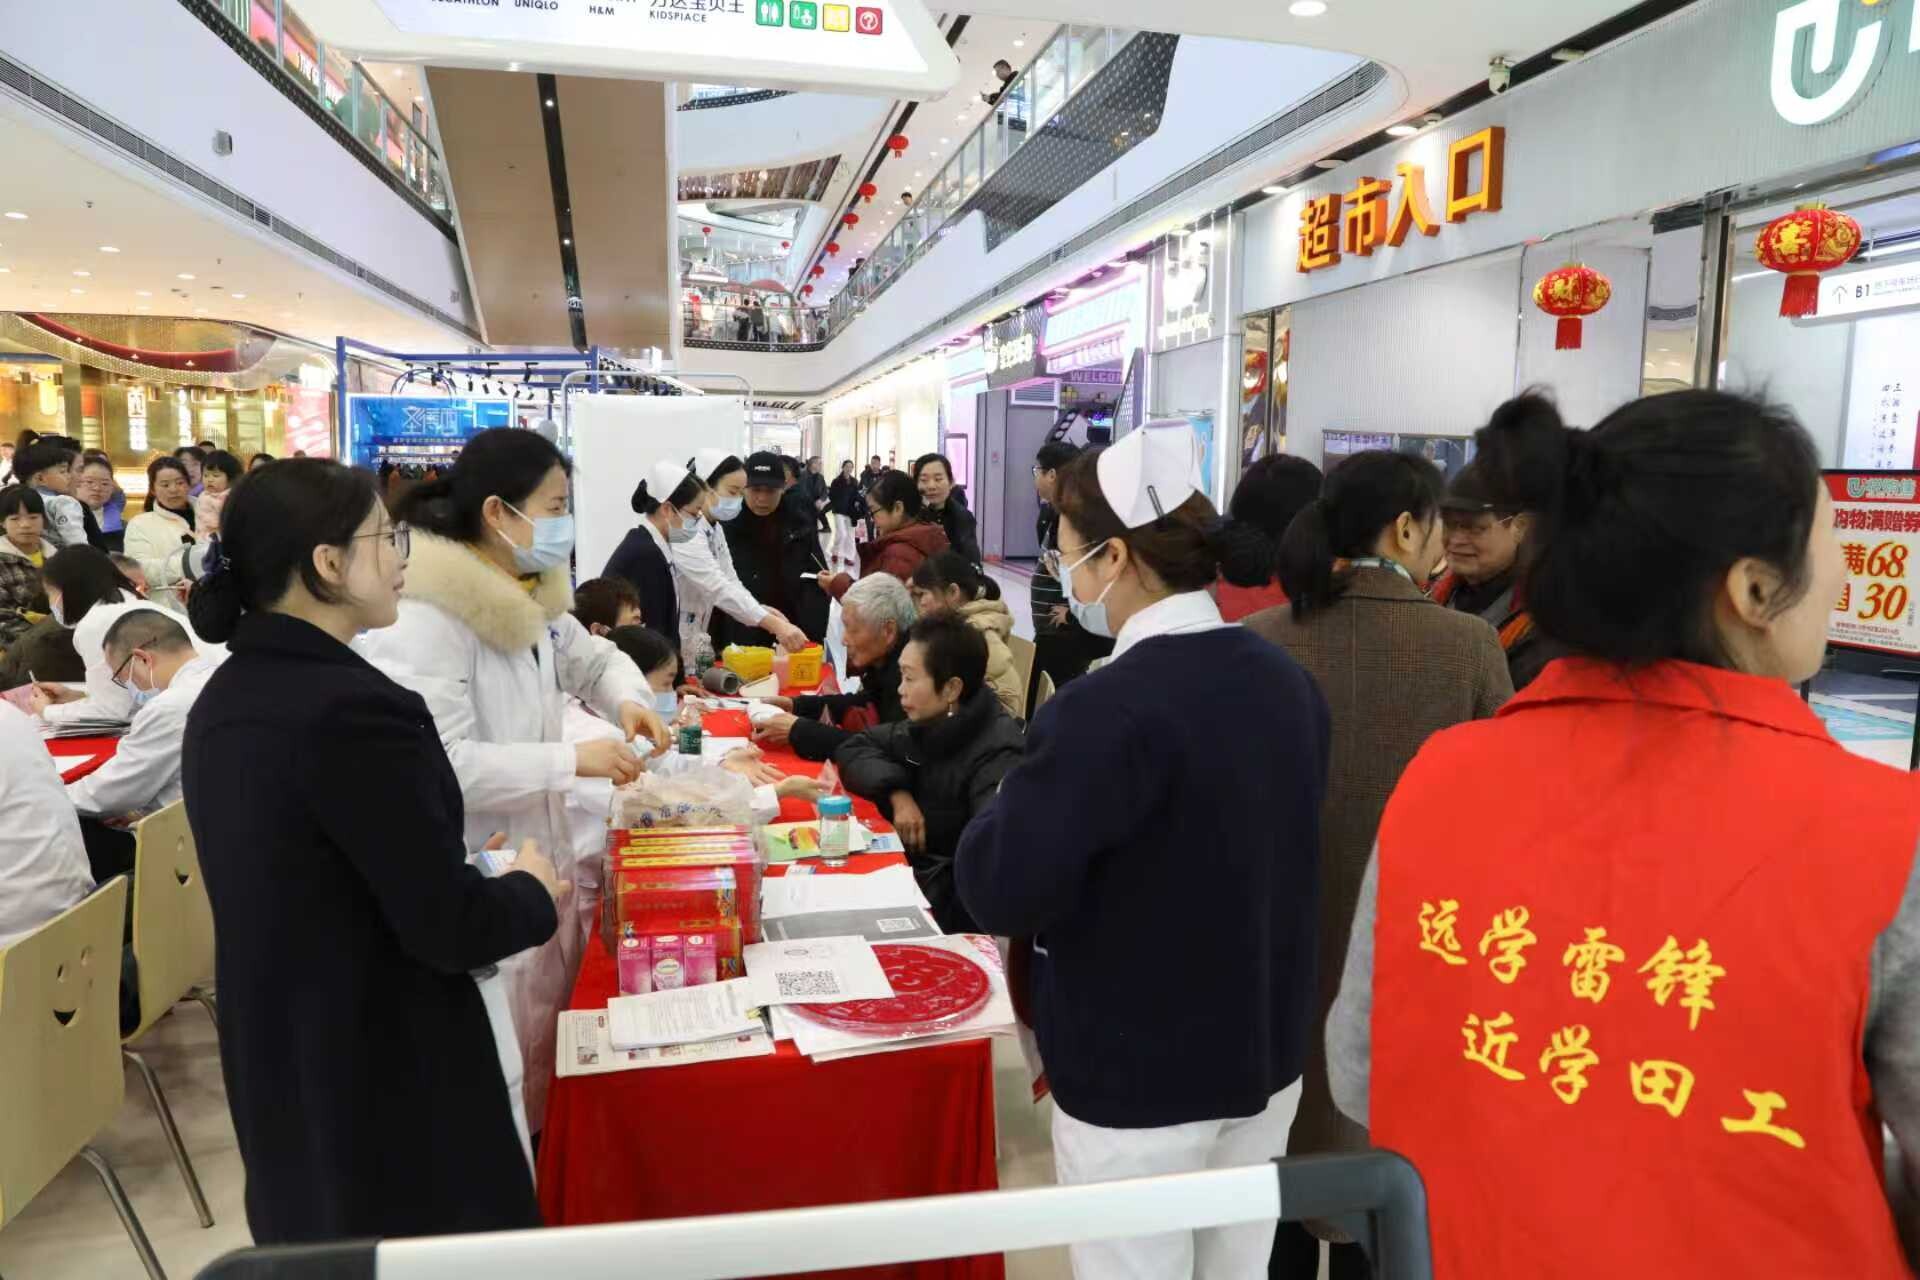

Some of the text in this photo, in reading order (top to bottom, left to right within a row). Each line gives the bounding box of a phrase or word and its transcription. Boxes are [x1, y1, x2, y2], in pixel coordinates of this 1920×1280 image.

[514, 0, 558, 10] UNIQLO
[589, 5, 614, 15] H&M
[1297, 126, 1505, 272] 超市入口
[1418, 899, 1726, 1030] 远学雷锋
[1461, 1011, 1806, 1148] 近学田工
